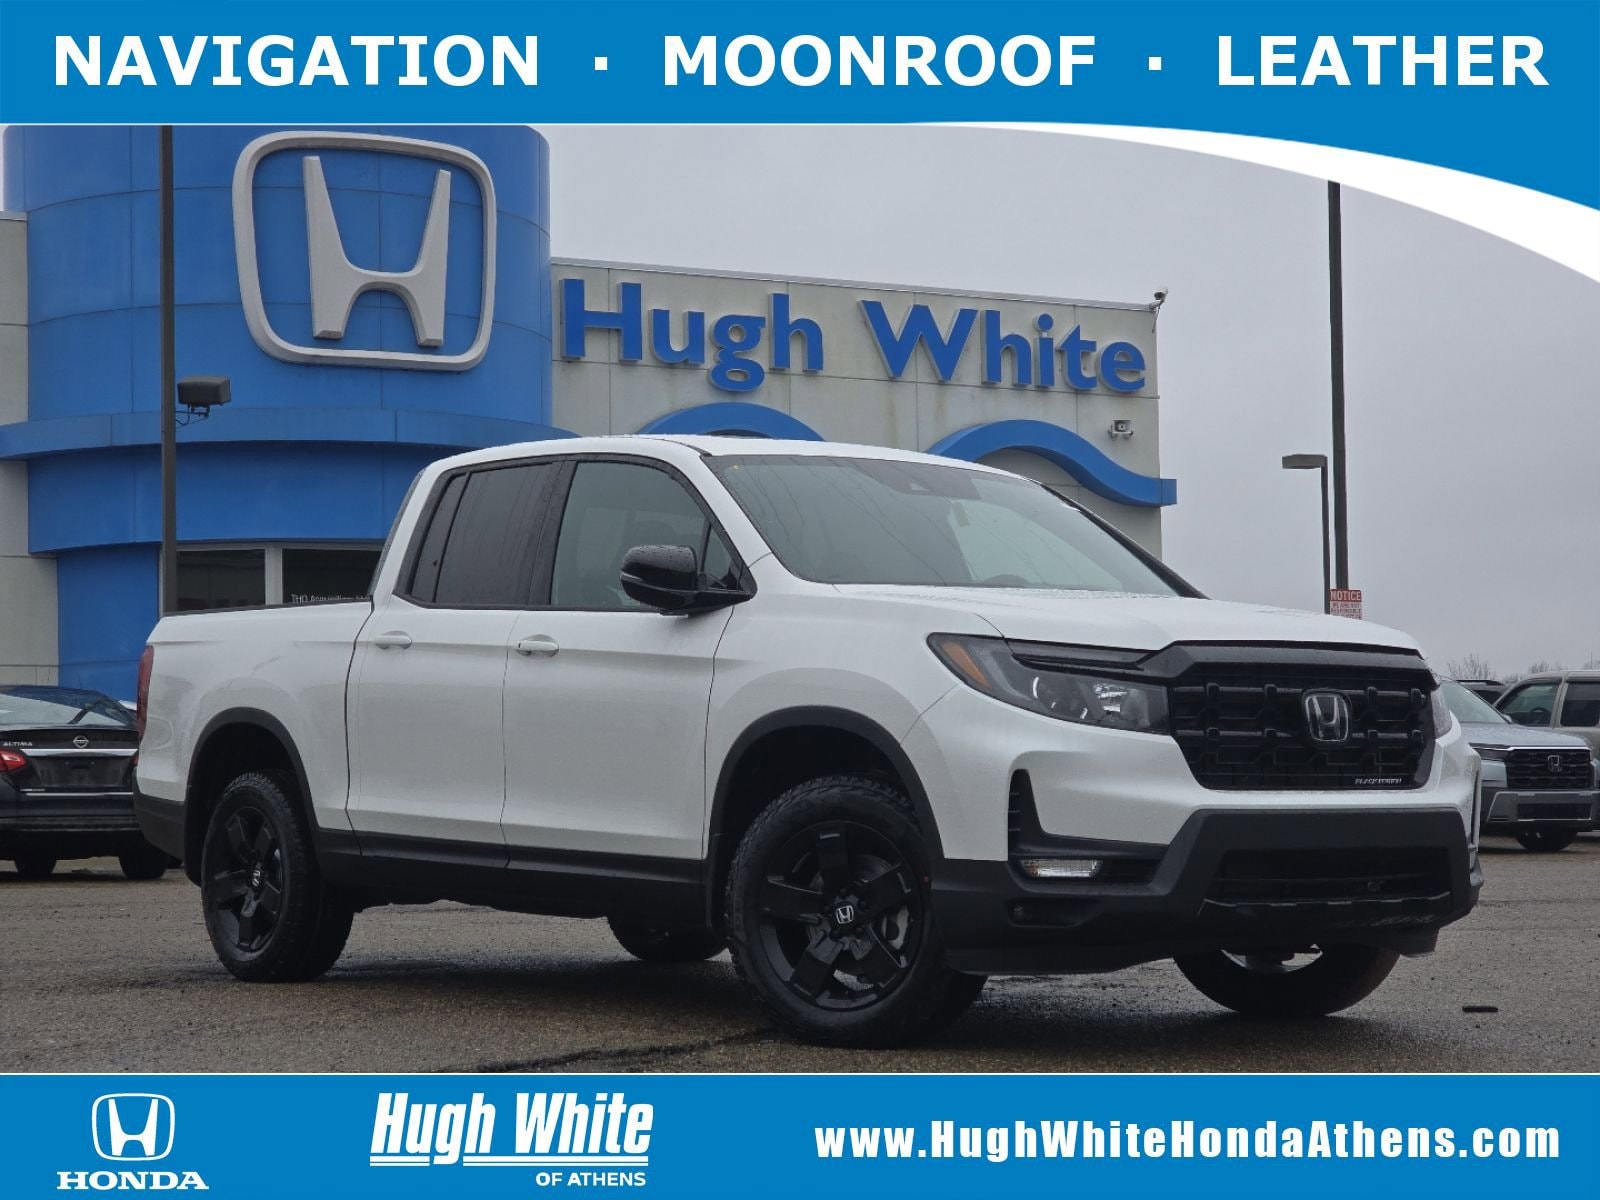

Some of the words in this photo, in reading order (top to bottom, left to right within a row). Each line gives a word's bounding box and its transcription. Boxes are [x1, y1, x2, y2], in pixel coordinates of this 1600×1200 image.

[560, 278, 824, 393] Hugh
[858, 300, 1146, 393] White
[1330, 591, 1361, 601] NOTICE
